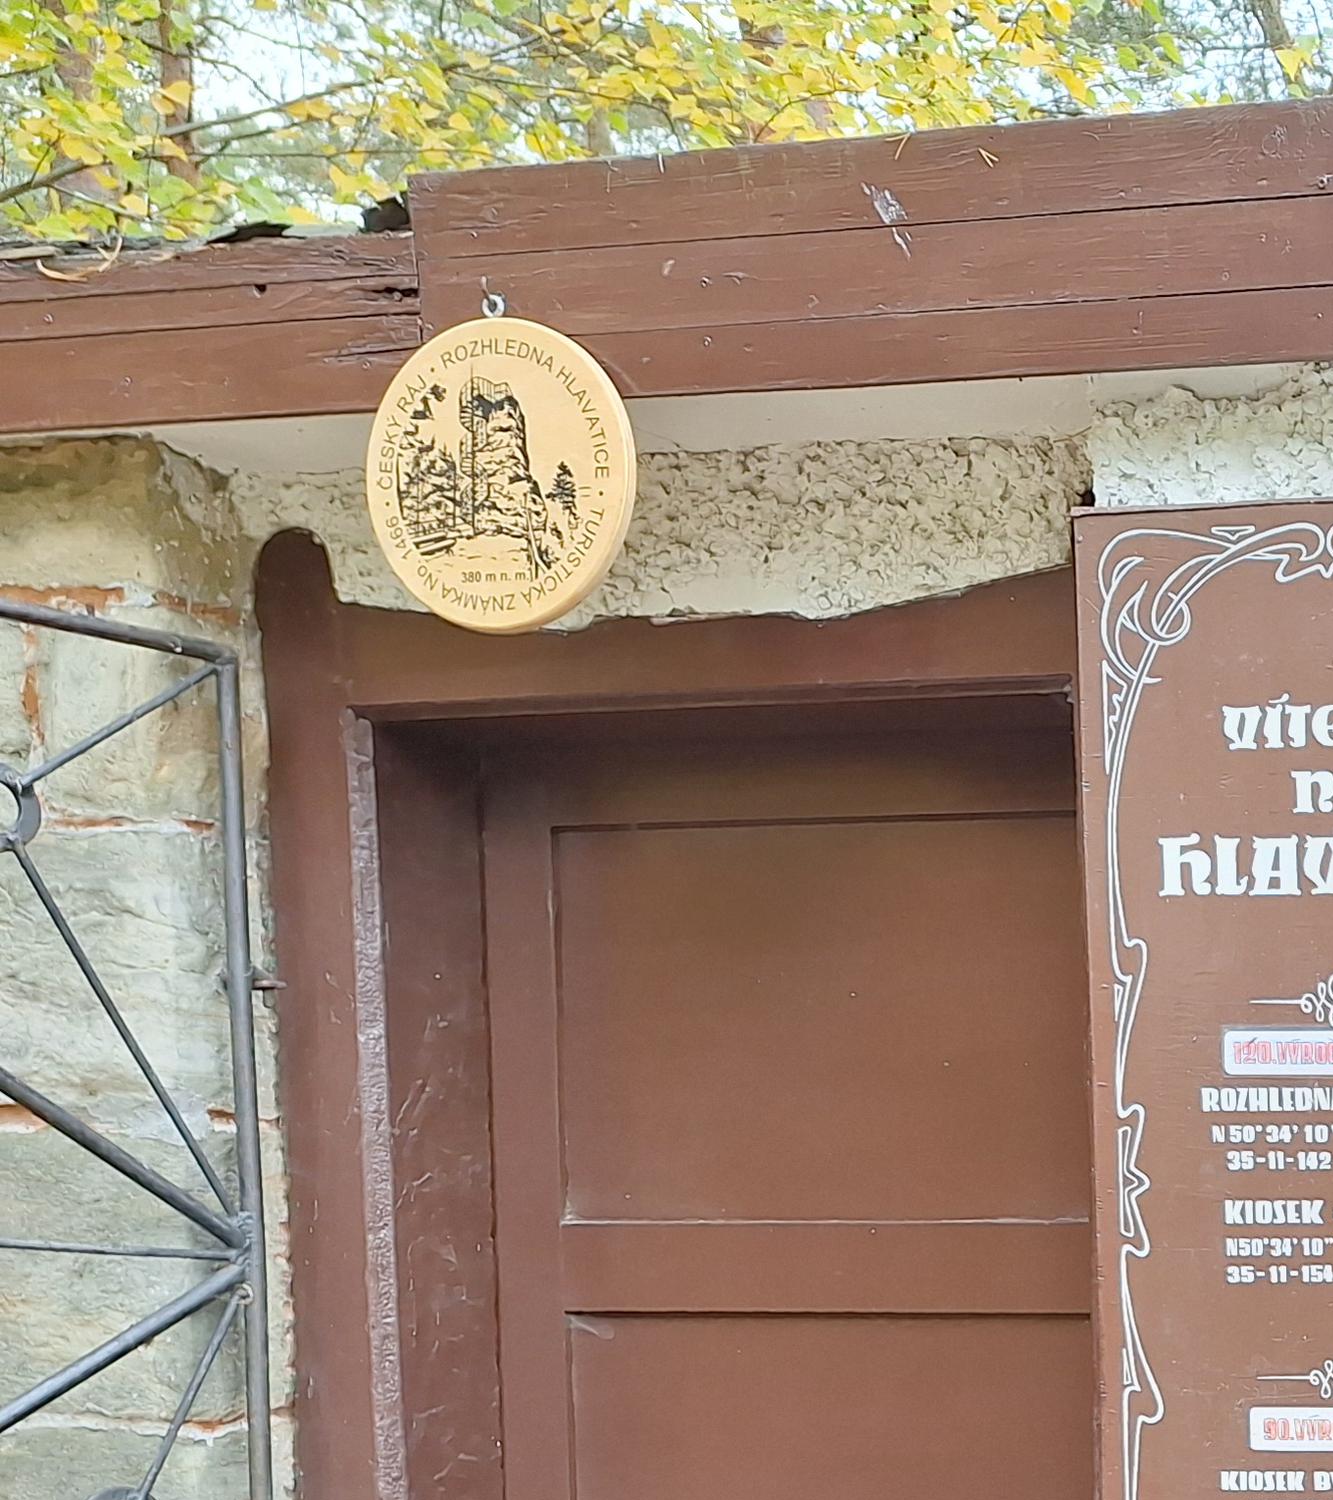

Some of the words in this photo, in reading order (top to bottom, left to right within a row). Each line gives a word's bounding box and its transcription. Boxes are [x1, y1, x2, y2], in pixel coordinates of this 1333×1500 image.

[397, 373, 428, 413] RÁJ
[441, 338, 554, 371] ROZHLEDNA
[556, 367, 610, 479] HLAVATICE
[386, 514, 412, 560] 1466
[521, 508, 604, 608] TURISTICKÁ
[461, 571, 482, 583] 380
[442, 578, 516, 616] ZNÁMKA
[1226, 1150, 1333, 1171] 35-11-142
[1224, 1200, 1324, 1225] KIOSEK
[1226, 1264, 1333, 1284] 35-11-154
[1220, 1470, 1305, 1493] KIOSEK
